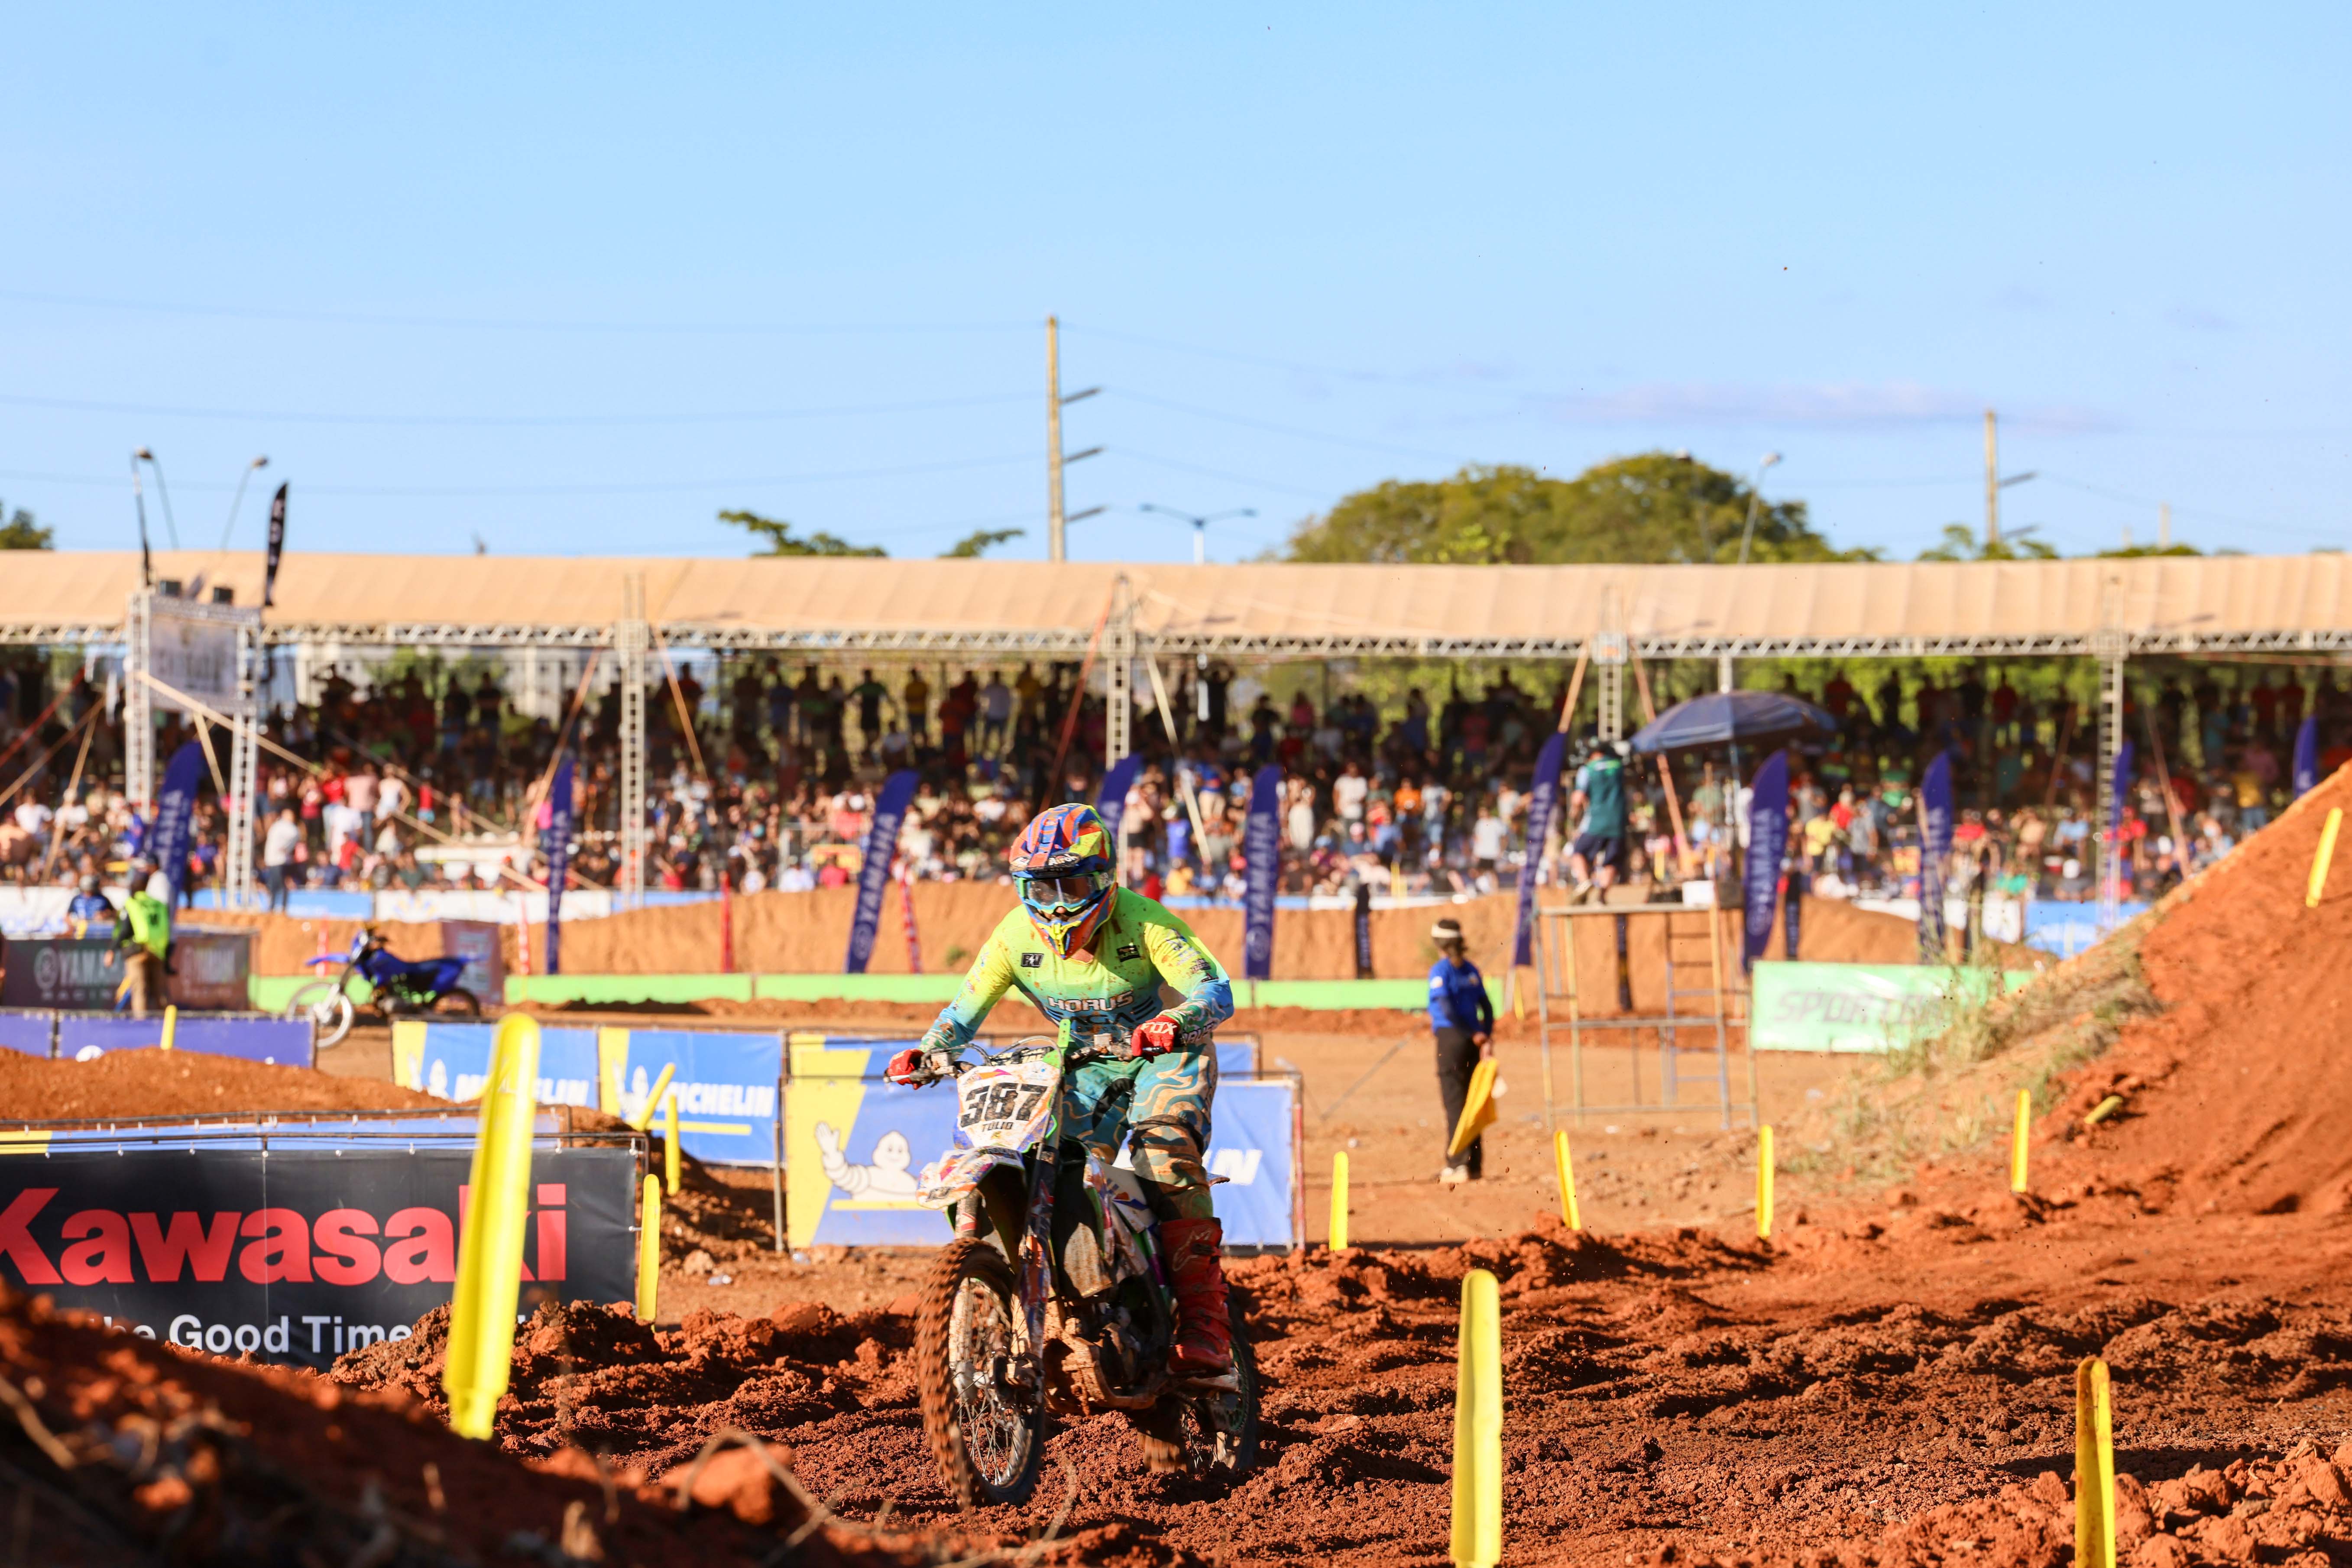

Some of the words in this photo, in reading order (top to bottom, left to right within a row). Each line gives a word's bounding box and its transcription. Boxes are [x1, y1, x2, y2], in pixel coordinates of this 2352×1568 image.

[1047, 990, 1134, 1013] HORUS
[1140, 1021, 1178, 1035] FOX
[960, 1082, 1048, 1128] 387
[982, 1121, 1015, 1132] TULIO
[169, 1314, 289, 1353] Good
